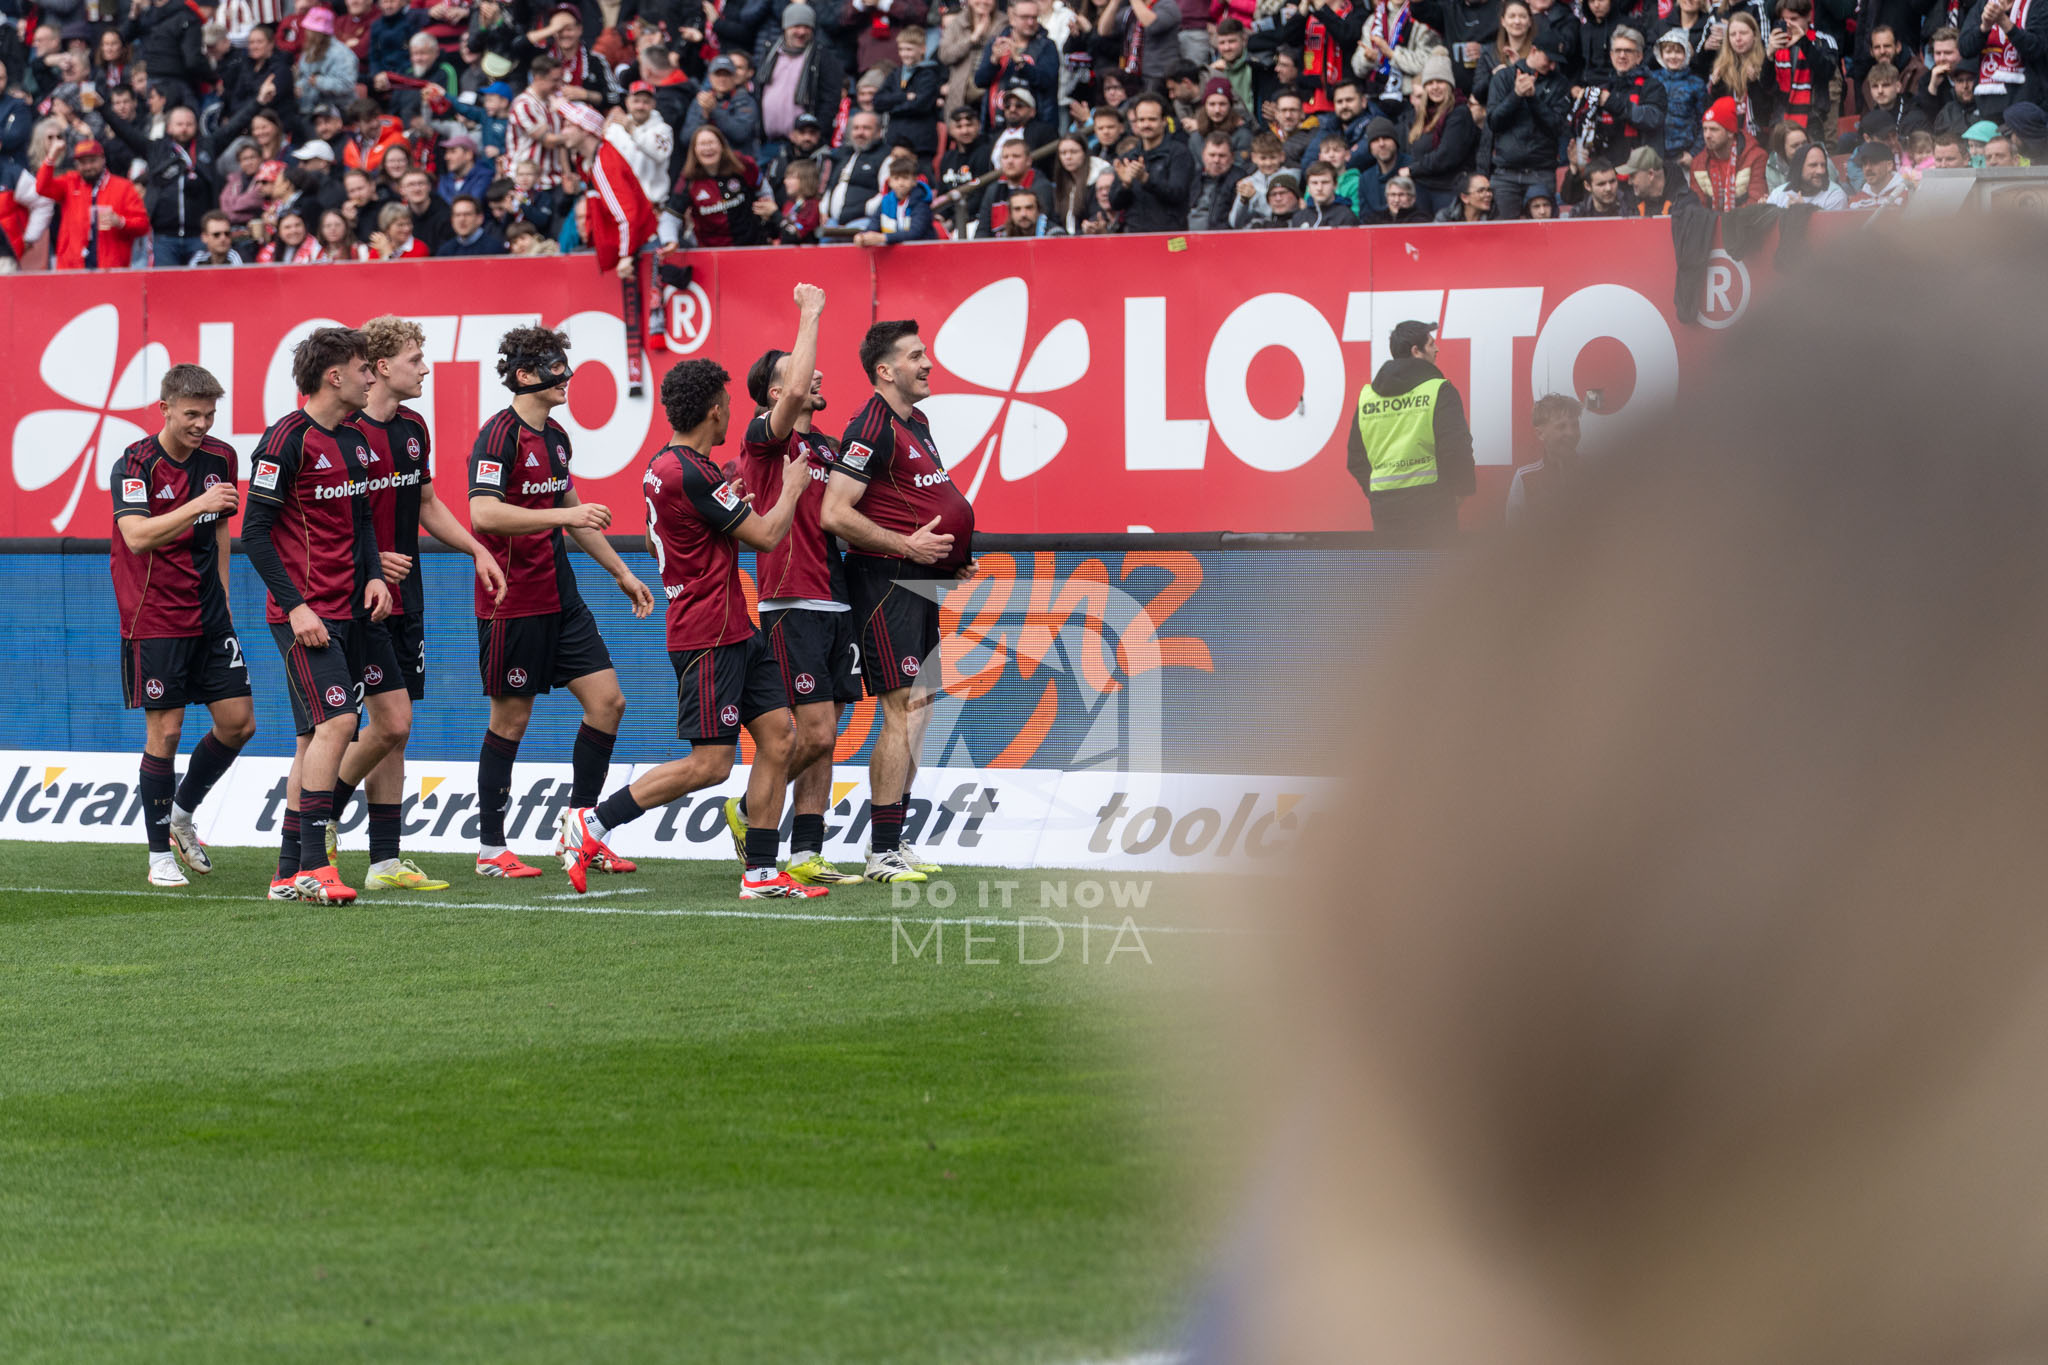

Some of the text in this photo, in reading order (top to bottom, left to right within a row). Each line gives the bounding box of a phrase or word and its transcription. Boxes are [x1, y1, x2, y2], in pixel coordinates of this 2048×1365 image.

[1383, 395, 1431, 412] POWER
[904, 664, 918, 672] FCN
[365, 671, 380, 682] FCN
[510, 675, 525, 683] FCN
[798, 681, 812, 689] FCN
[148, 687, 161, 695] FCN
[329, 693, 345, 702] FCN
[724, 713, 737, 721] FCN
[0, 766, 186, 826] lcra
[255, 776, 575, 842] tocrft
[654, 783, 999, 847] toraft
